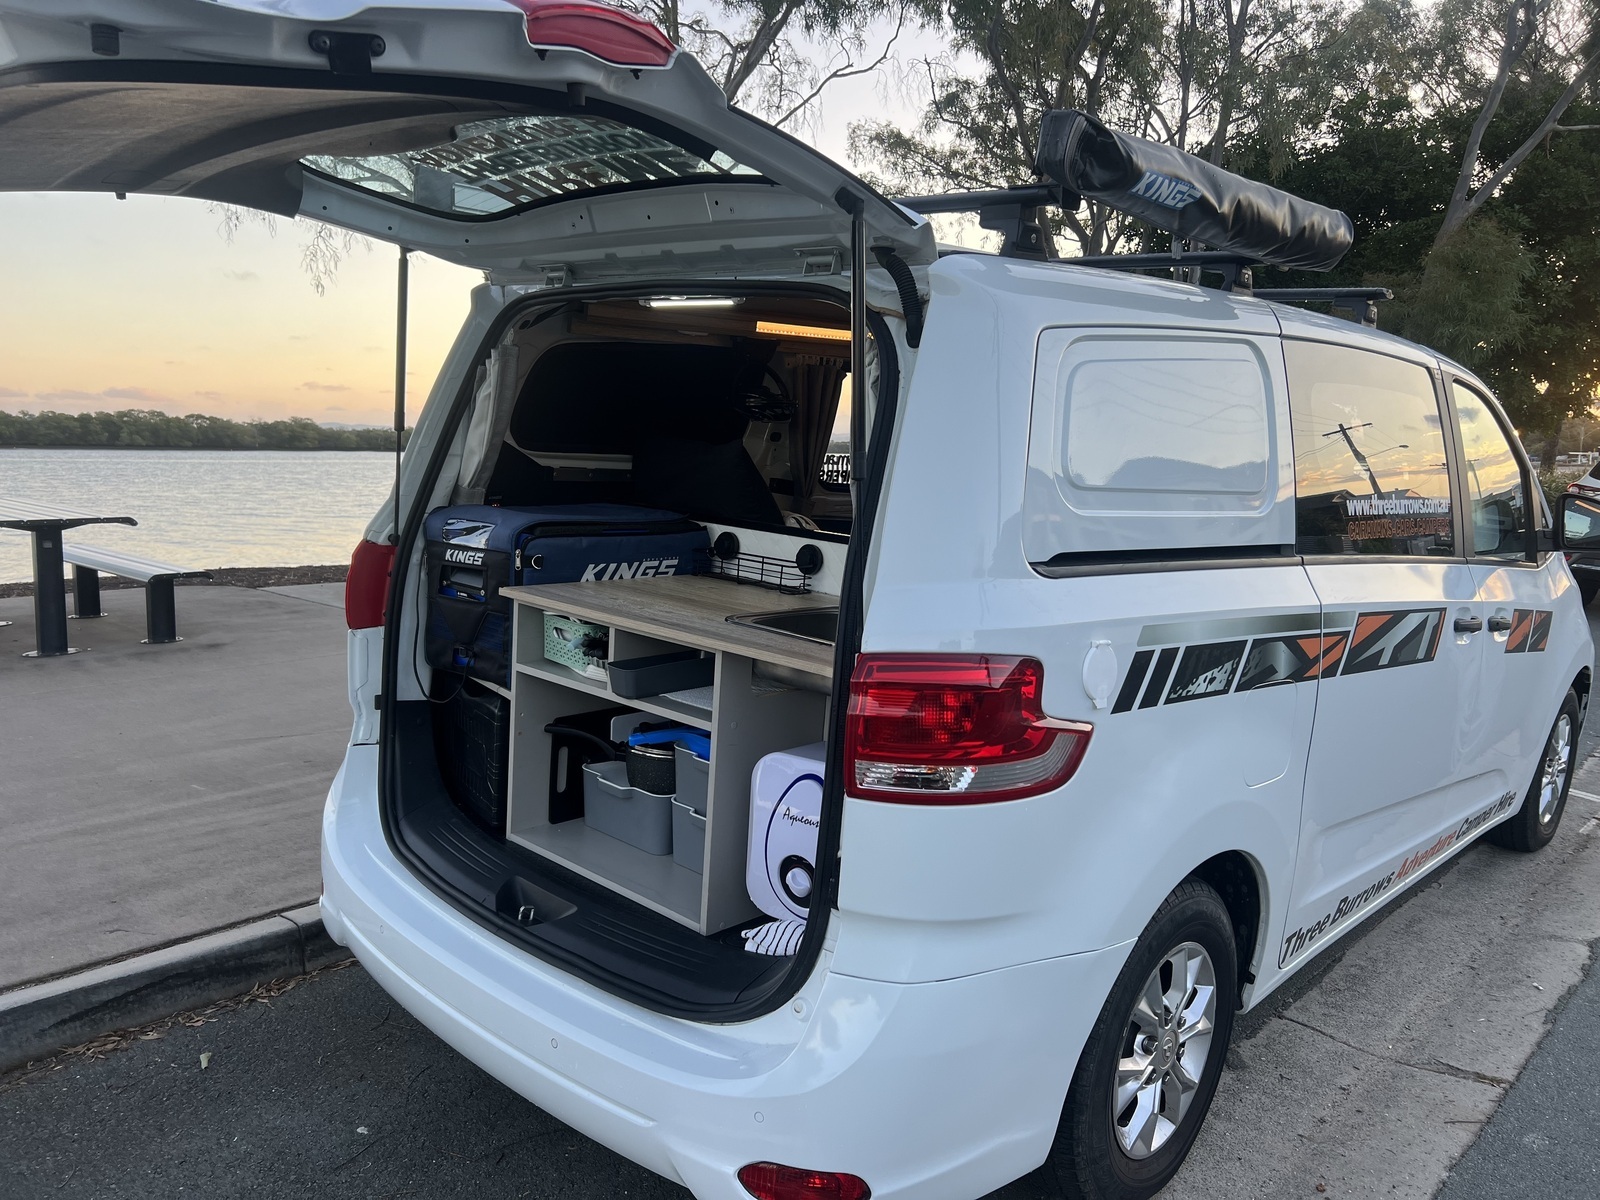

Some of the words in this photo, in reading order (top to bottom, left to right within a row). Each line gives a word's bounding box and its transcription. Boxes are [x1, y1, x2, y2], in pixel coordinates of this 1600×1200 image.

[1131, 171, 1202, 208] KINGS
[445, 549, 485, 565] KINGS
[580, 559, 679, 582] KINGS
[782, 806, 819, 828] Aqueous
[1280, 913, 1331, 965] Three
[1391, 830, 1458, 885] Adventure
[1455, 804, 1497, 840] Camper
[1493, 790, 1517, 815] Hire
